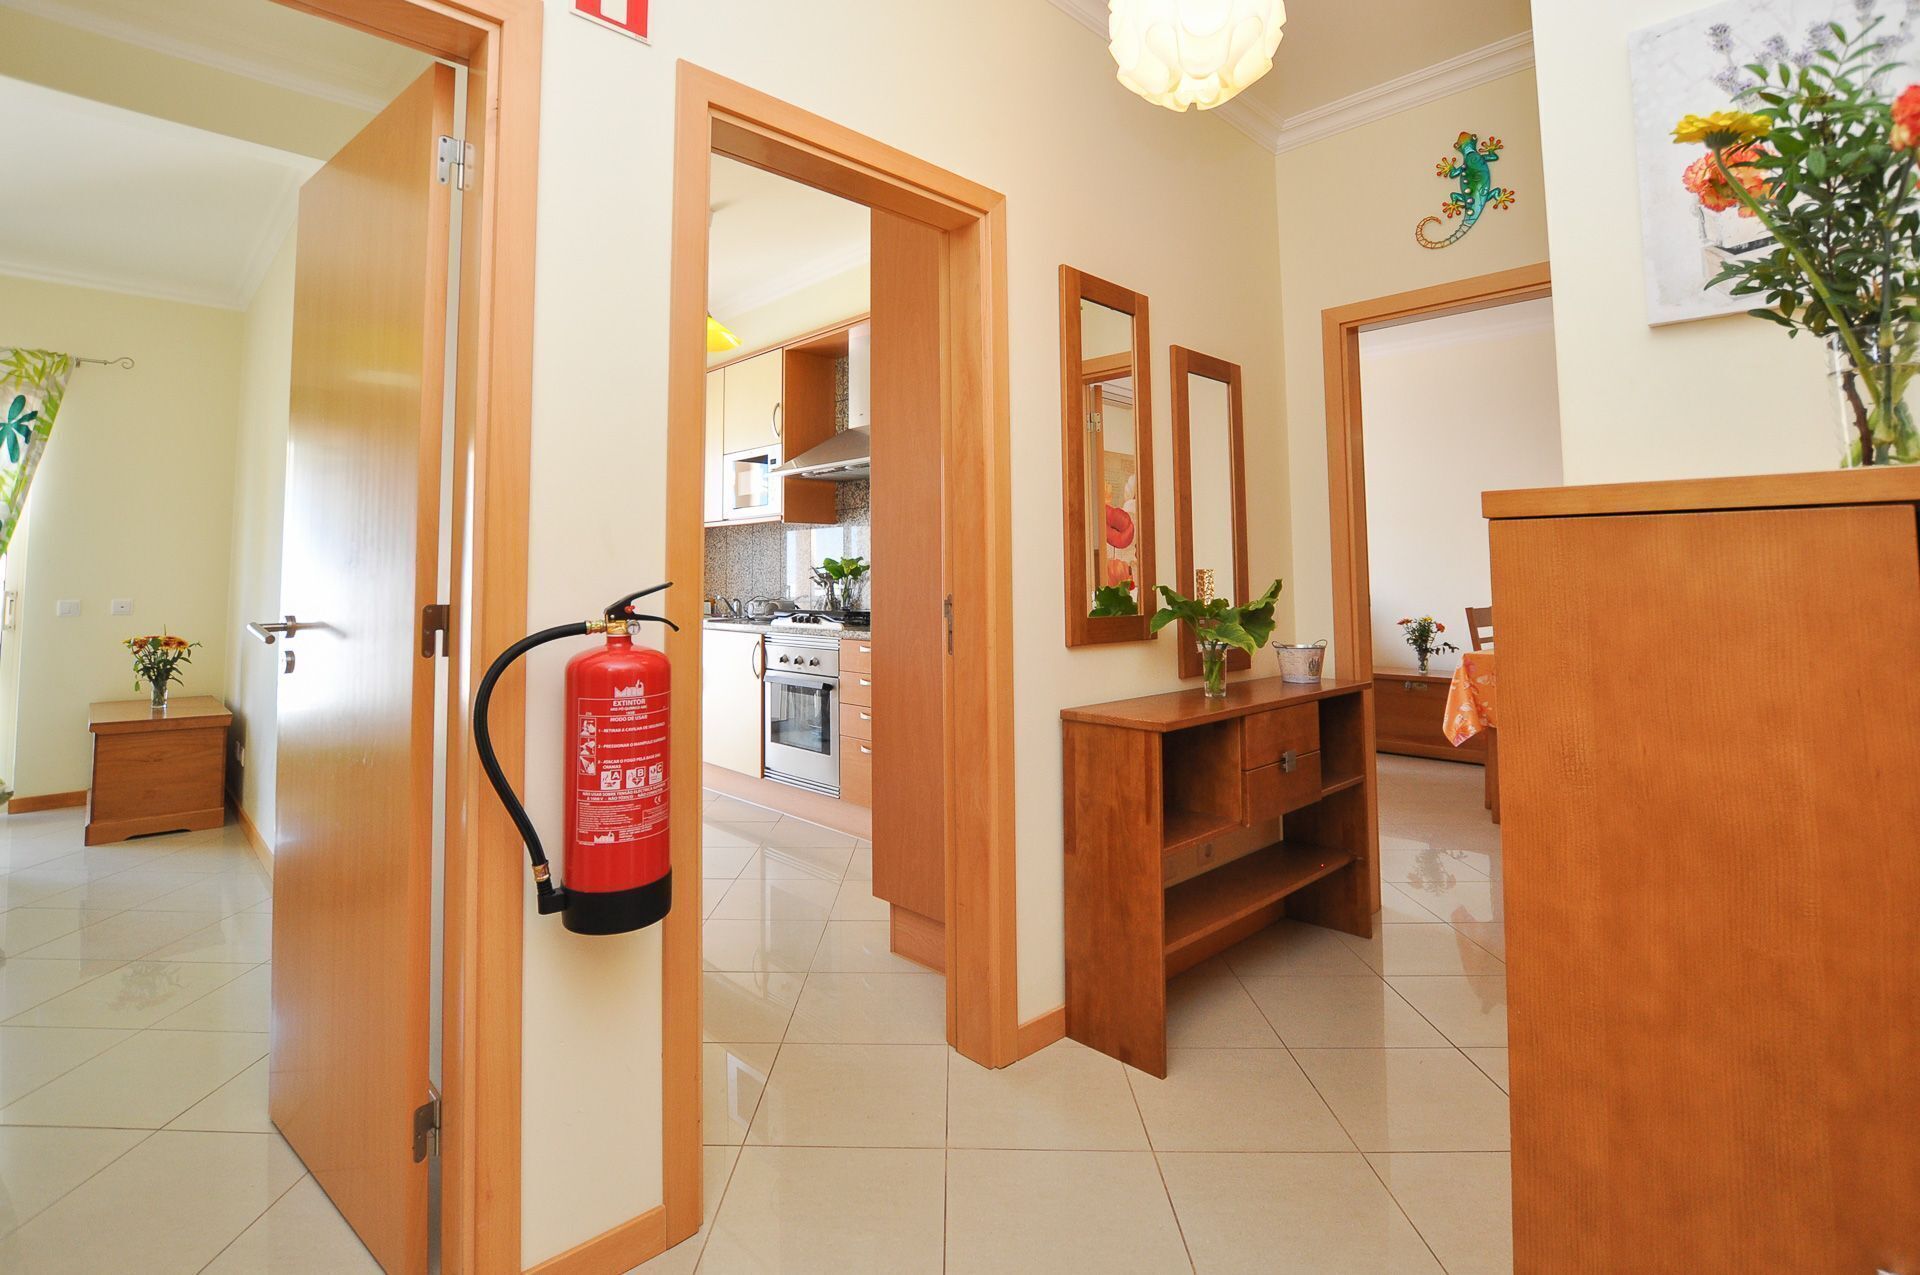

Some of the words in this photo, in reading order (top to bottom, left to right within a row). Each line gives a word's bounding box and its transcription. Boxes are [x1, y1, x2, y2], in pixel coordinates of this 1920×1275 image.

[613, 699, 646, 707] EXTINTOR
[657, 764, 663, 773] C
[612, 772, 620, 780] A
[637, 769, 644, 777] B
